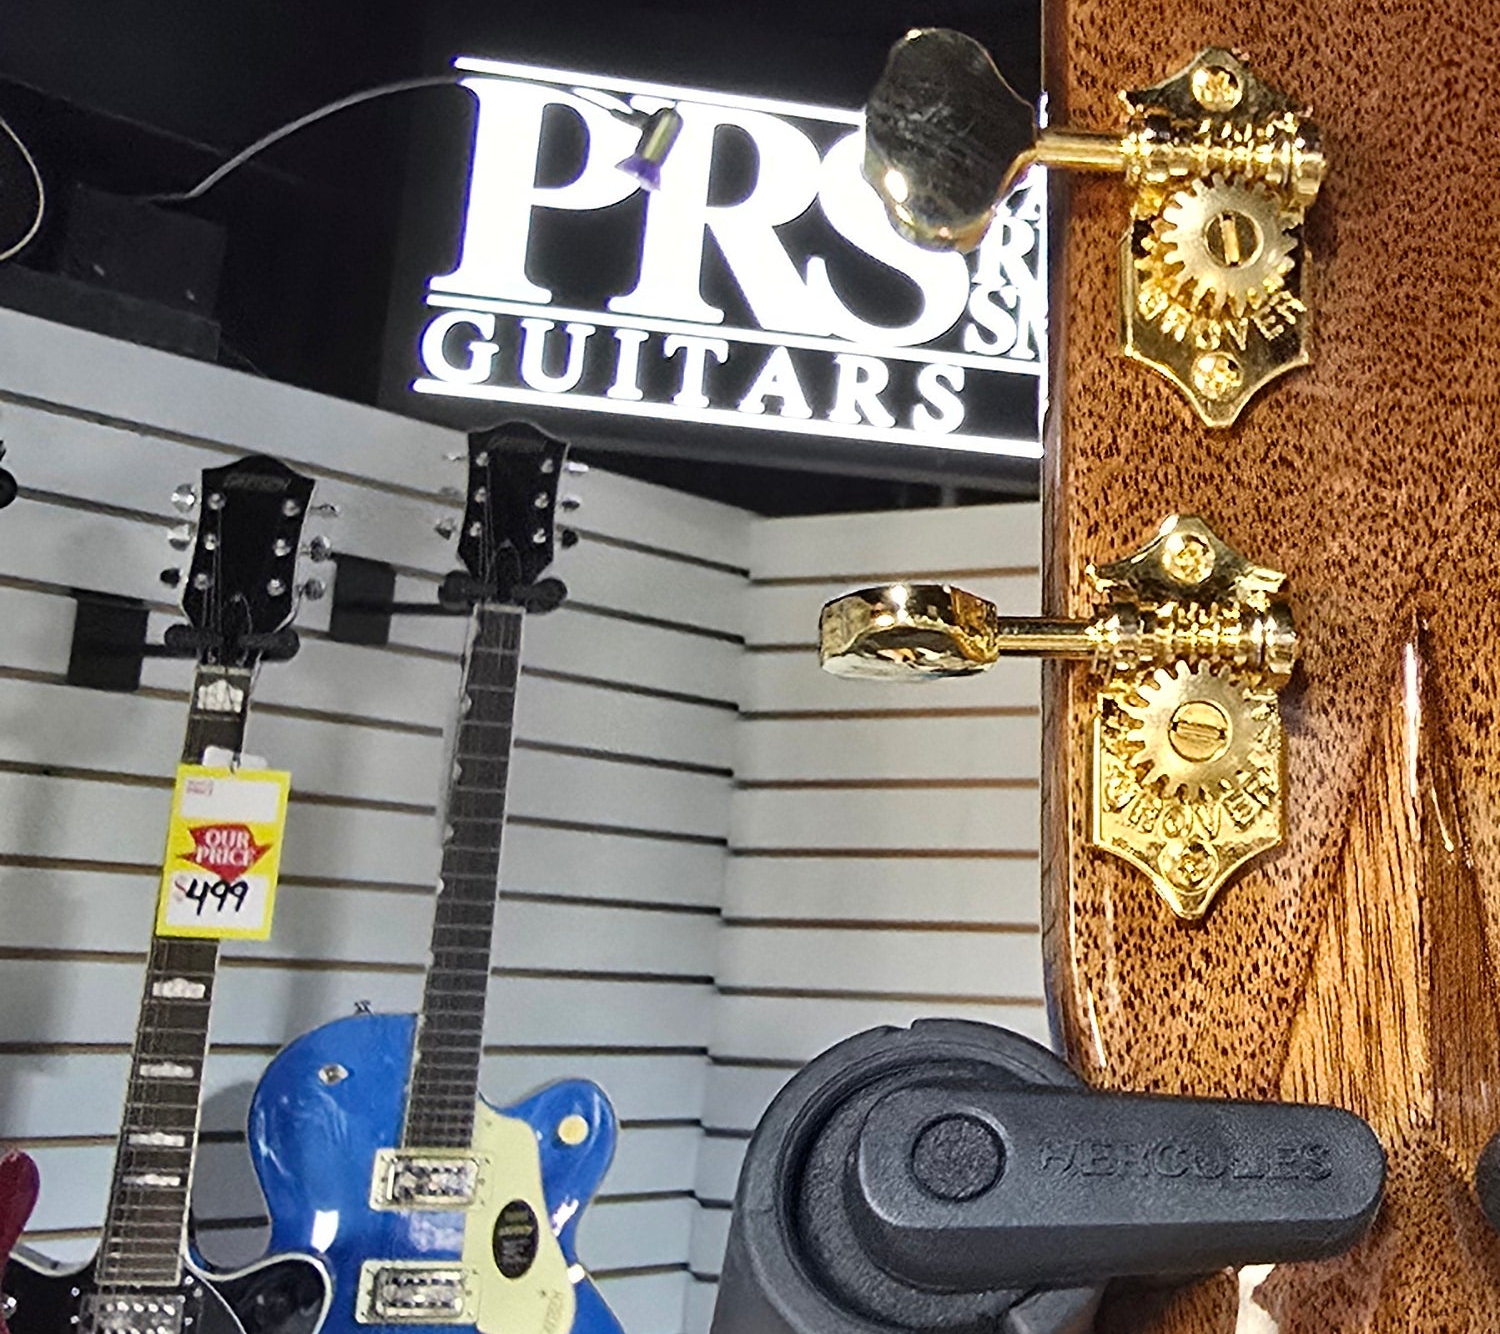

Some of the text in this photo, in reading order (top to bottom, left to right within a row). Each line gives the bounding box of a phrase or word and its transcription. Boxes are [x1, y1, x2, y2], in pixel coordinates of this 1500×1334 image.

[424, 76, 970, 348] PRS
[419, 309, 966, 436] GUITARS
[196, 845, 257, 867] PRICE
[205, 829, 250, 849] OUR
